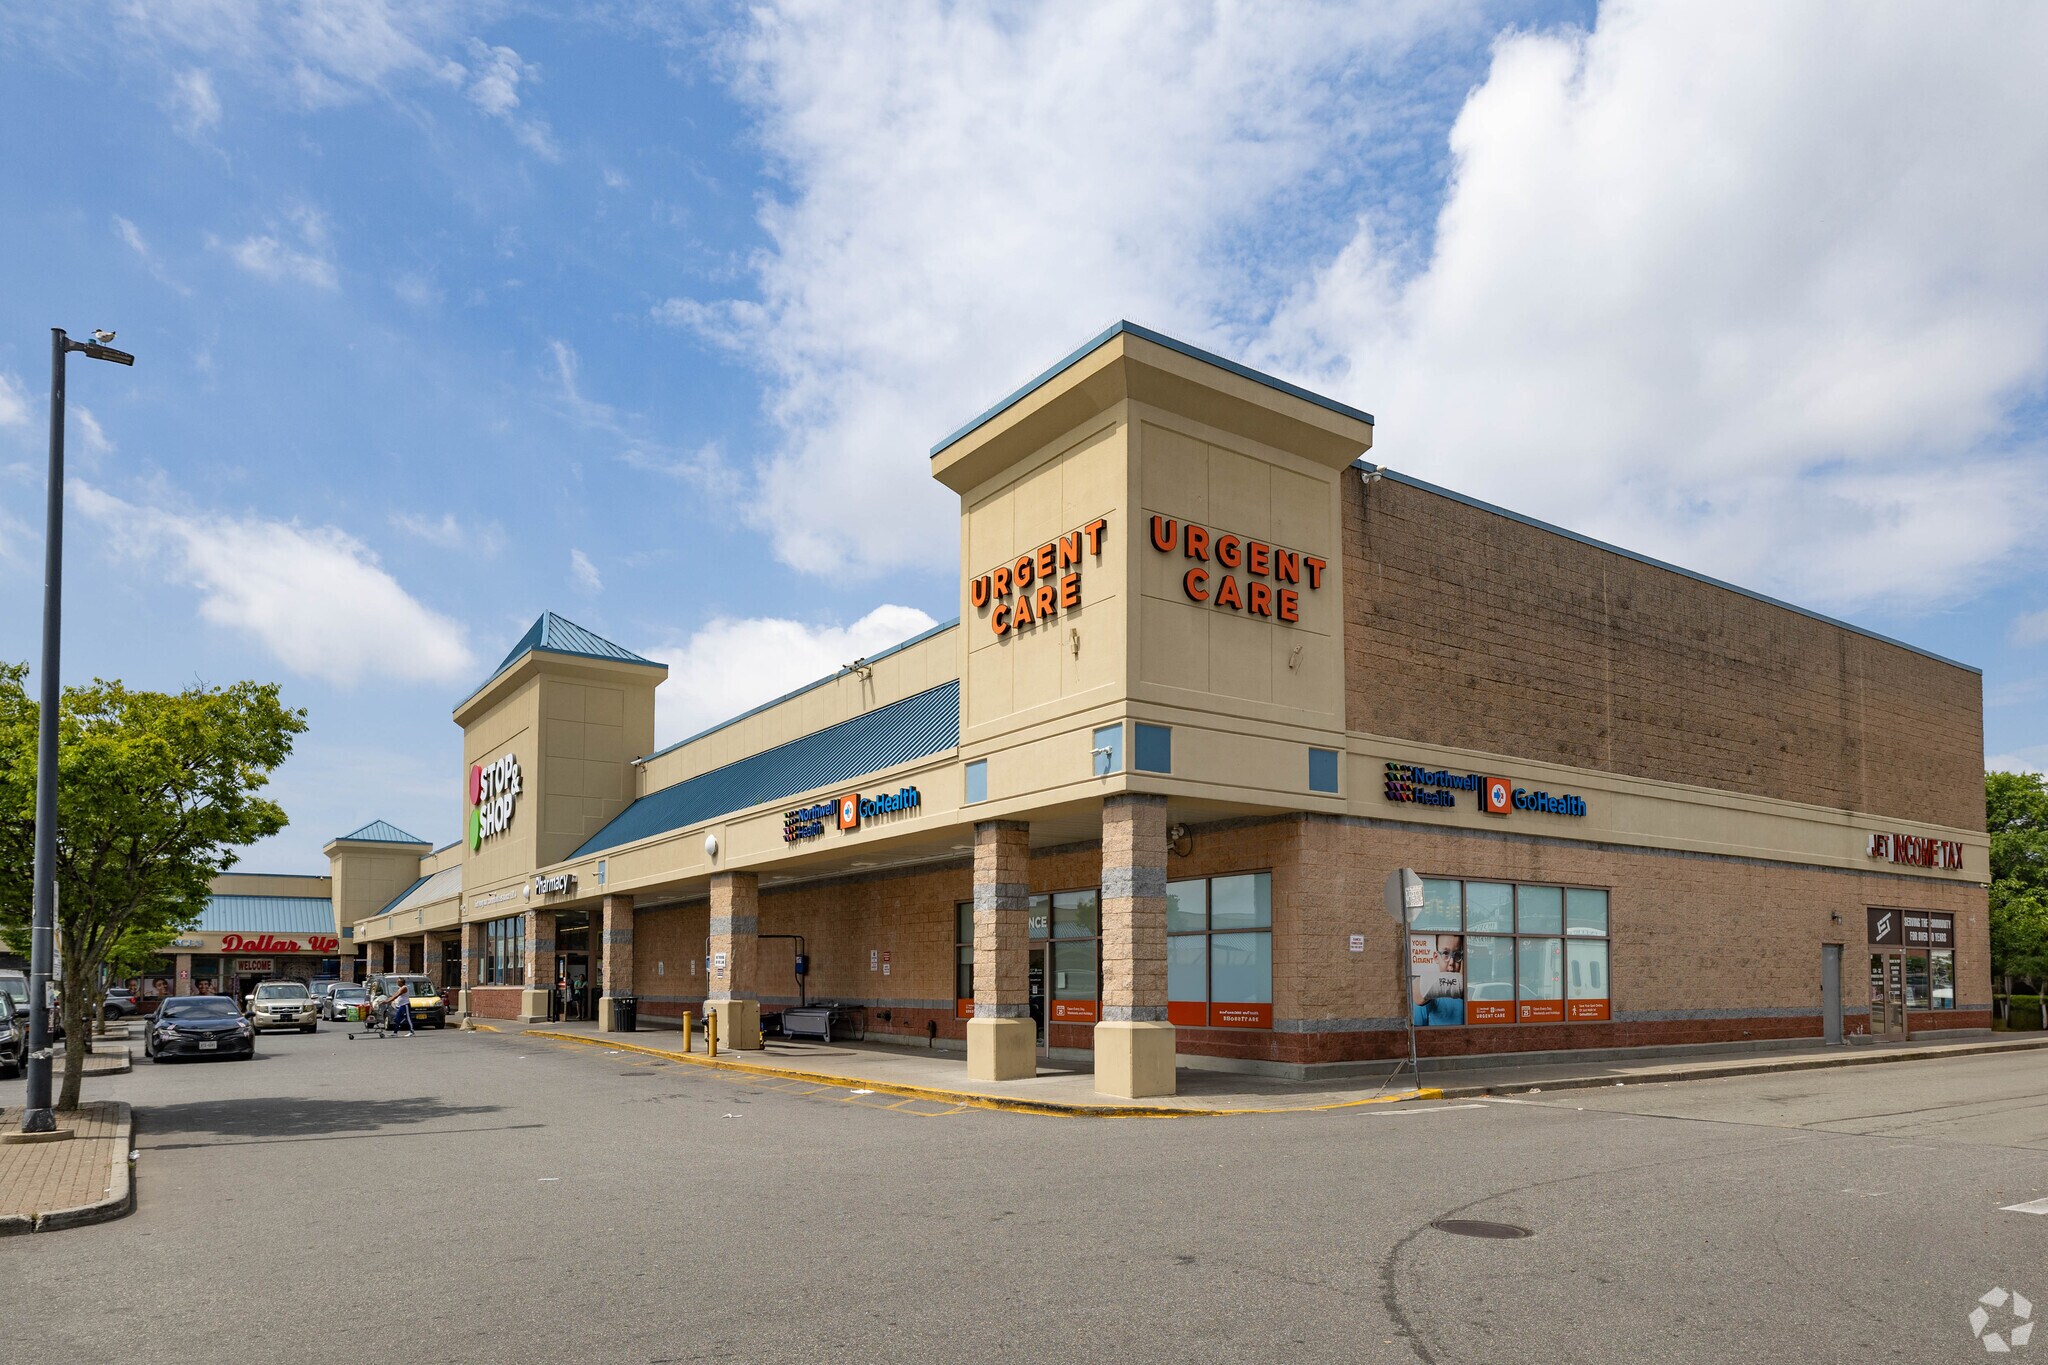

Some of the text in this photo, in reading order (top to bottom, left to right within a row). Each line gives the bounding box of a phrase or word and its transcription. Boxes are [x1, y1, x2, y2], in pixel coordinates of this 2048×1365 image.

[971, 518, 1108, 609] URGENT
[1150, 515, 1327, 590] URGENT
[991, 572, 1082, 636] CARE
[1183, 567, 1300, 623] CARE
[1412, 767, 1479, 791] Northwell
[798, 799, 838, 822] Northwell
[859, 786, 917, 818] GoHealth
[1413, 787, 1456, 808] Health
[1512, 788, 1587, 817] GoHealth
[479, 793, 515, 839] SHOP
[798, 820, 824, 838] Health
[1869, 834, 1963, 870] JET INCOME TAX
[535, 874, 571, 895] Pharmacy
[221, 934, 338, 954] Dollar Up
[237, 960, 272, 971] WELCOME
